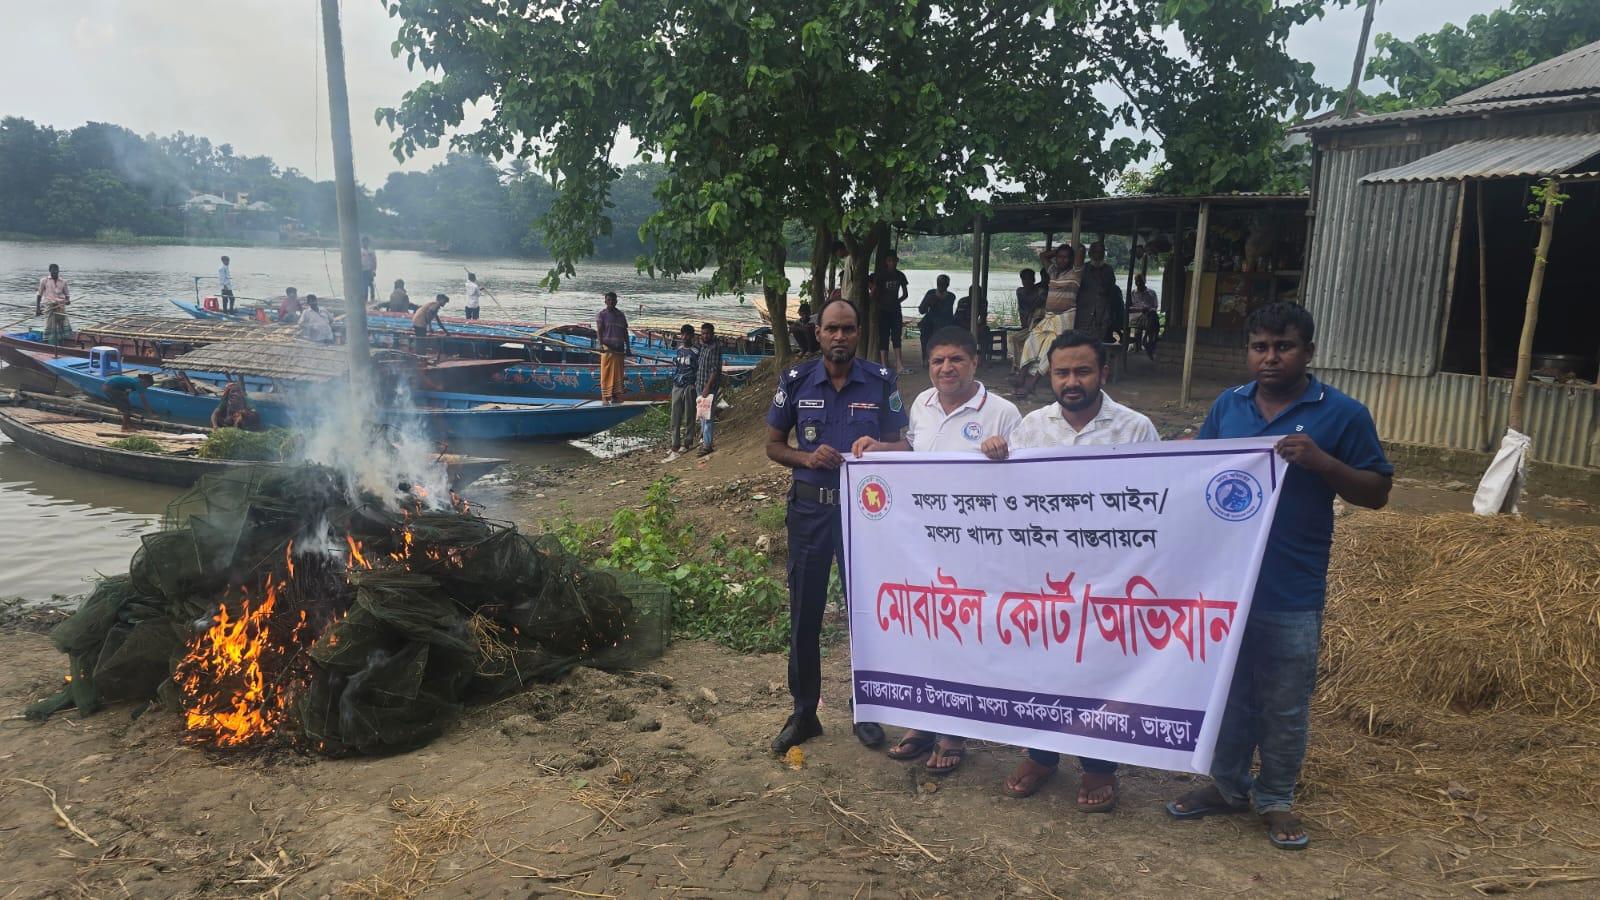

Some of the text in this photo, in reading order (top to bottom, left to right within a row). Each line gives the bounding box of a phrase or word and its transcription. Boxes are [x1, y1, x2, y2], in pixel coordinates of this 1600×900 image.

[912, 486, 1169, 516] মৎস্য সুরক্ষা ও সংরক্ষণ আইন/
[925, 523, 1158, 549] মৎস্য খাদ্য আইন বাস্তবায়নে
[877, 567, 987, 645] মোবাইল
[860, 680, 913, 703] বাস্তবায়নে
[925, 683, 973, 712] উপজেলা
[977, 696, 1009, 717] মৎস্য
[1011, 697, 1074, 725] কর্মকর্তার
